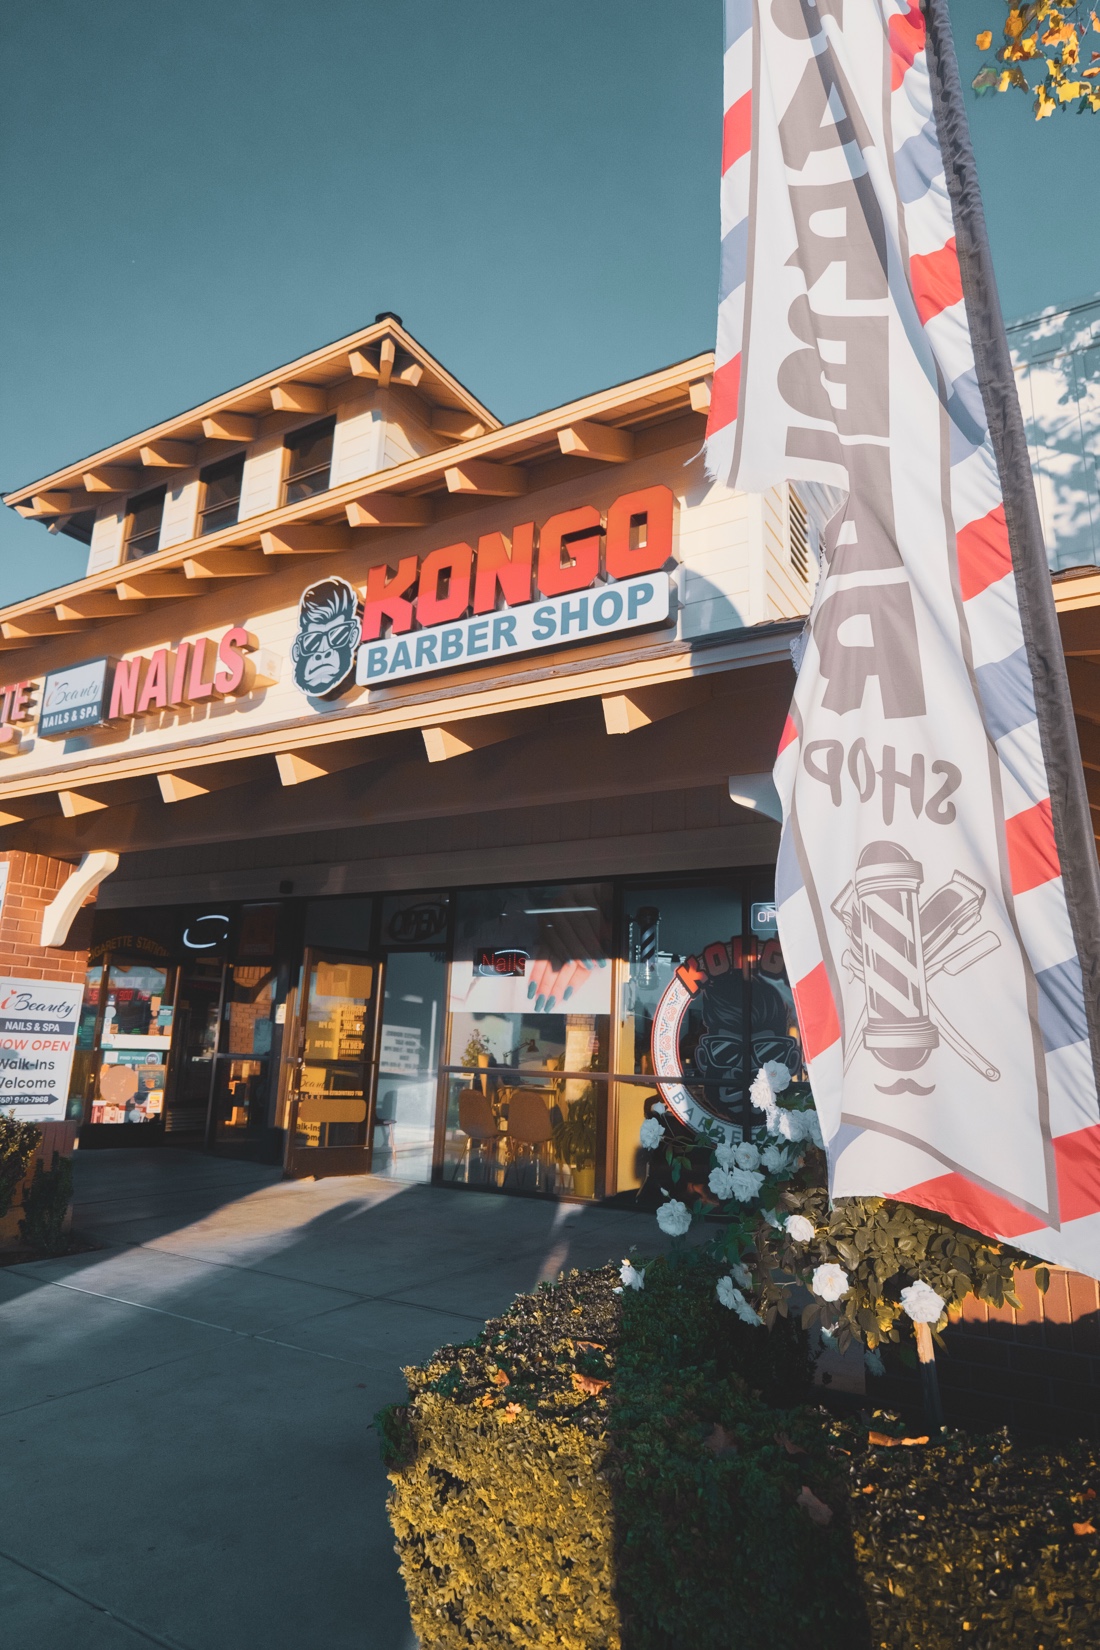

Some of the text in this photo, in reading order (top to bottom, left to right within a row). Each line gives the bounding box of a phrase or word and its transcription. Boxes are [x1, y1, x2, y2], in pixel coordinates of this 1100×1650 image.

[361, 483, 674, 642] KONGO
[366, 582, 655, 679] BARBER SHOP
[109, 627, 251, 719] NAILS
[42, 705, 98, 729] NAILS & SPA
[757, 911, 777, 923] OP
[482, 953, 526, 972] Nails
[676, 937, 785, 994] KONG
[5, 1021, 60, 1032] NAILS & SPA
[31, 1040, 71, 1051] OPEN
